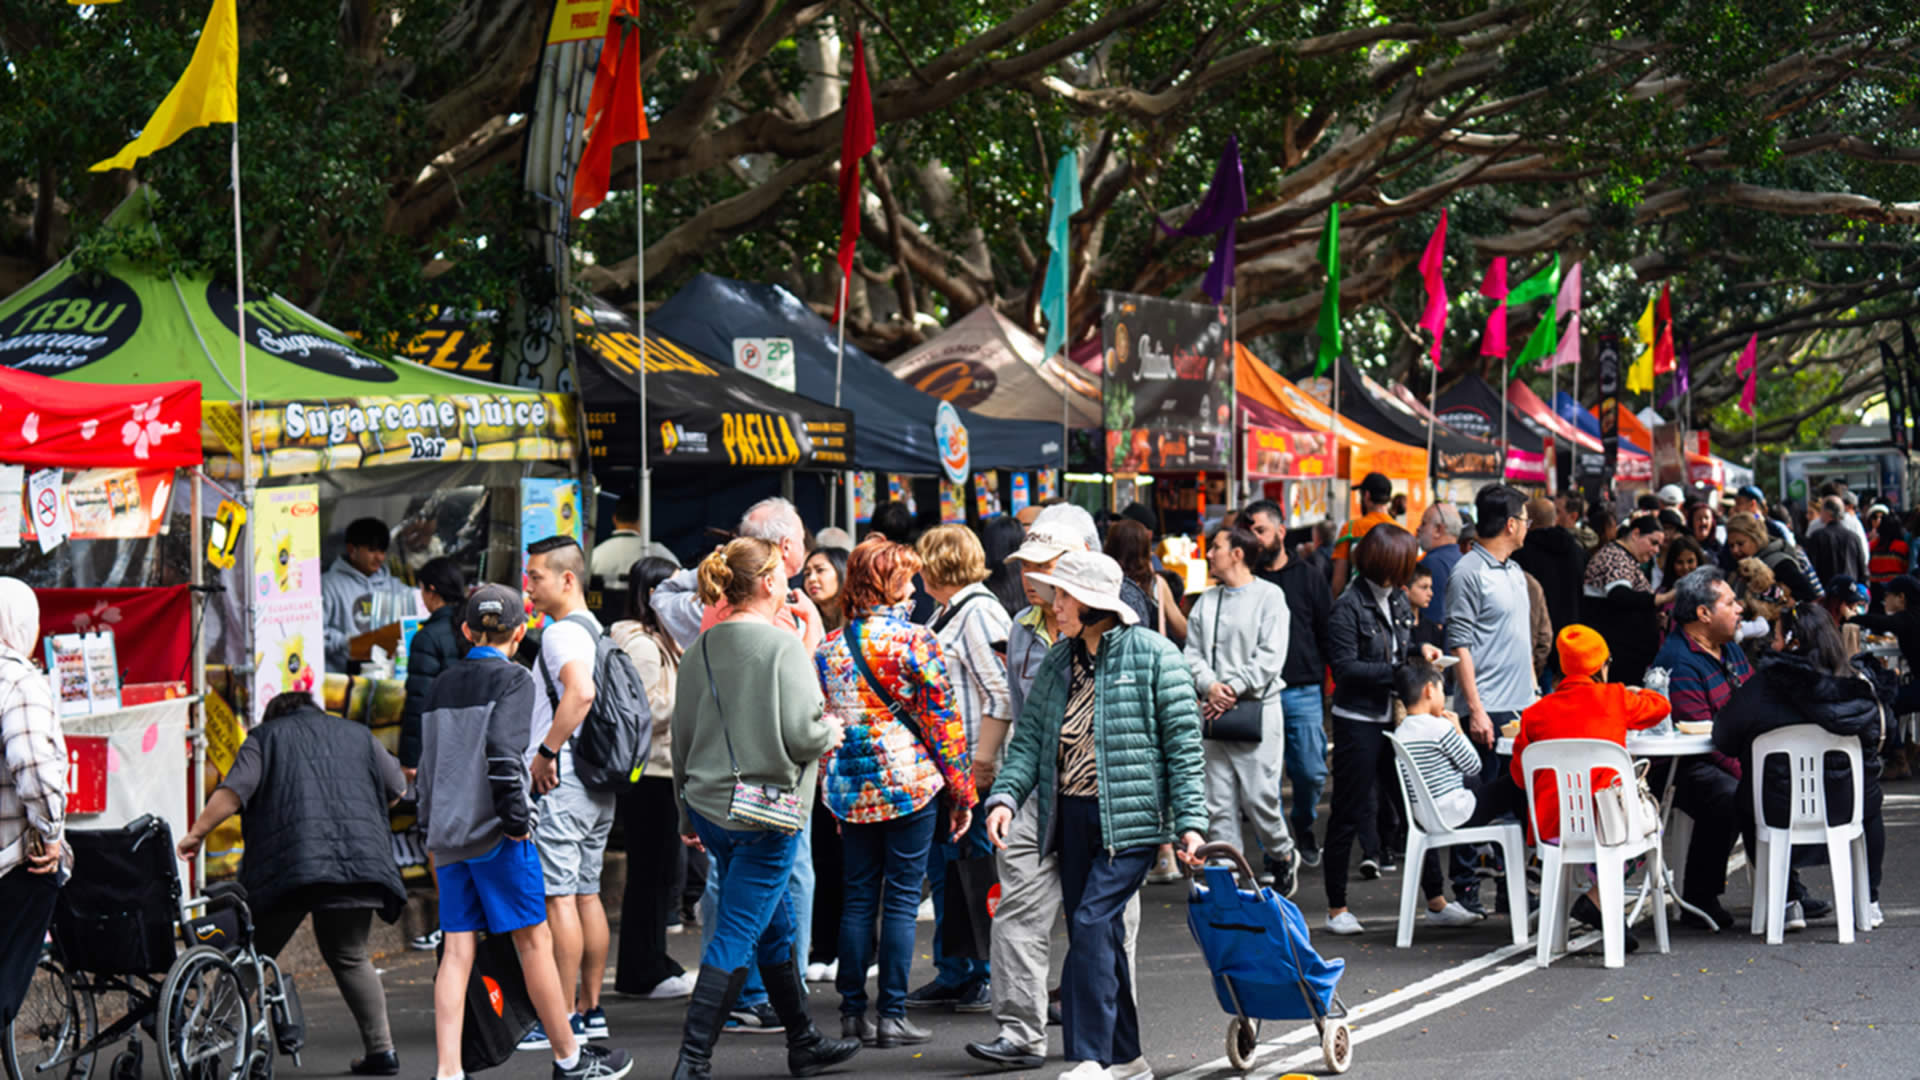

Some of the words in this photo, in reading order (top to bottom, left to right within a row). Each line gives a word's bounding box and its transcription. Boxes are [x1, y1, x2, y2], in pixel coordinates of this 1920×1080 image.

[11, 298, 127, 335] TEBU
[0, 333, 108, 350] arcane
[768, 342, 790, 360] 2P
[285, 402, 456, 442] Sugarcane
[465, 396, 546, 429] Juice
[408, 433, 446, 459] Bar
[721, 412, 800, 465] PAELLA
